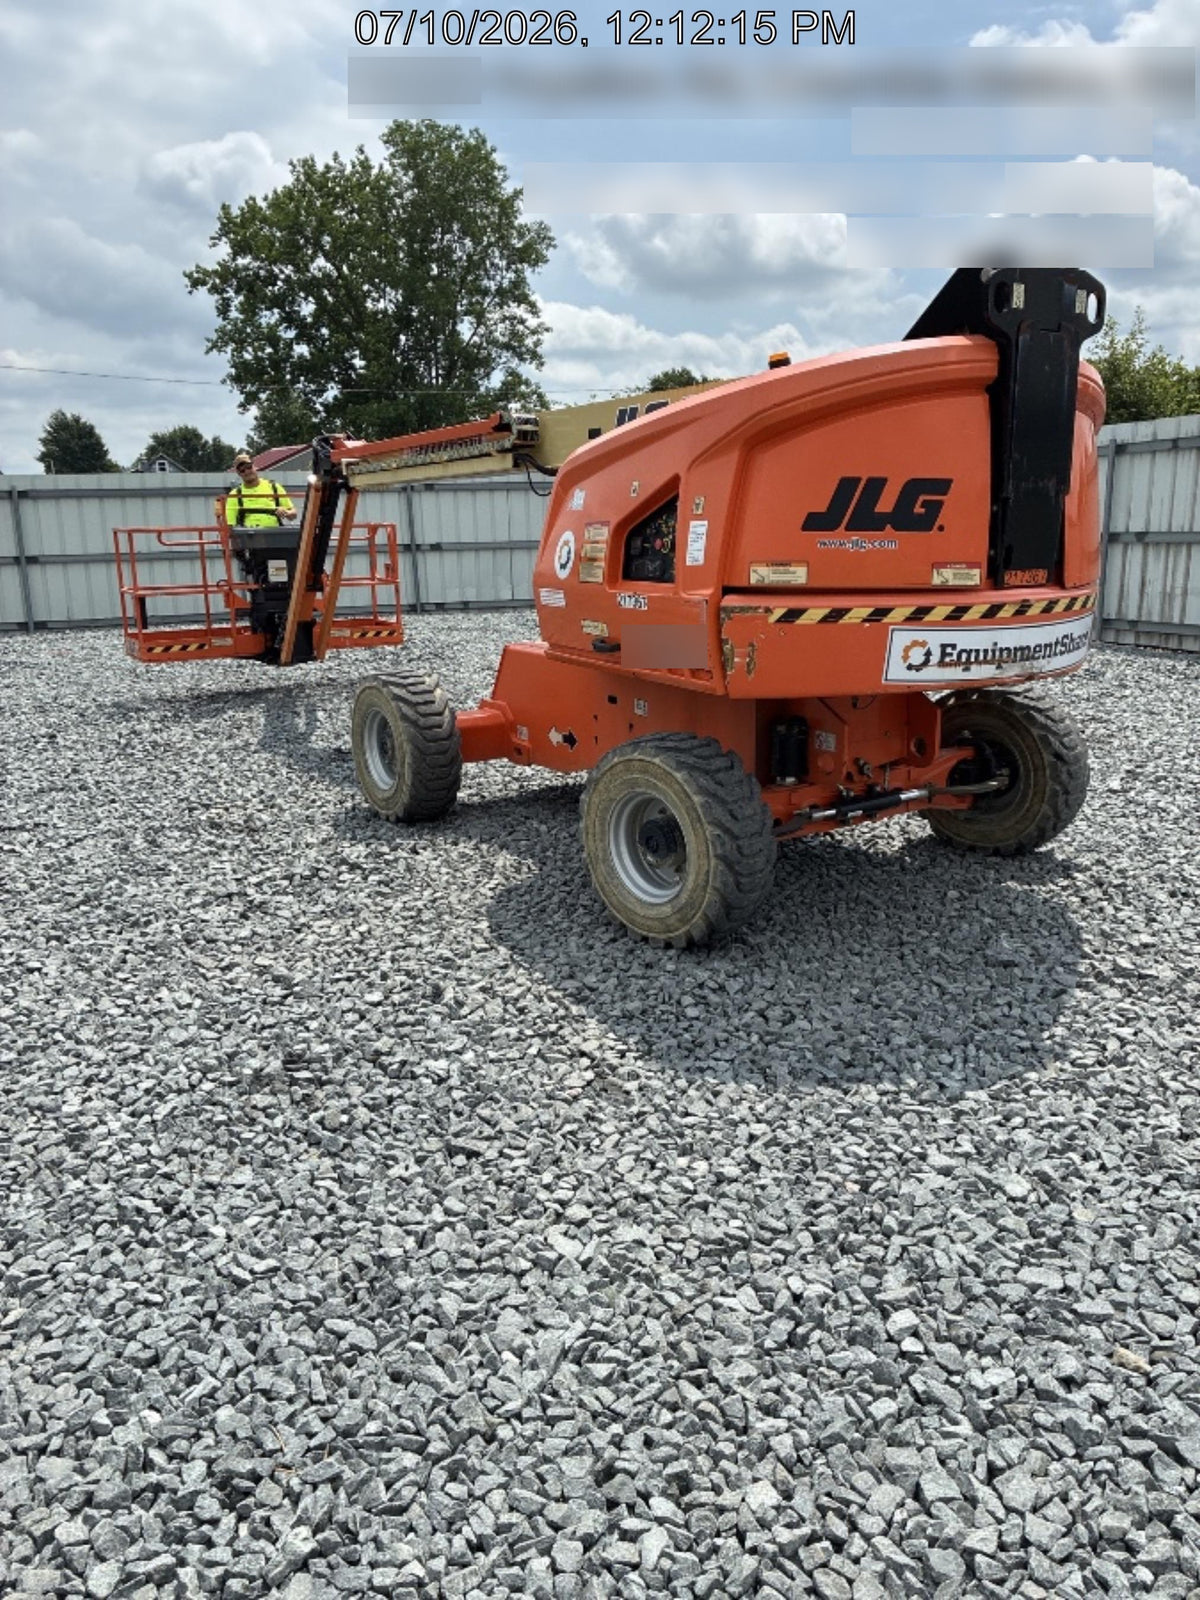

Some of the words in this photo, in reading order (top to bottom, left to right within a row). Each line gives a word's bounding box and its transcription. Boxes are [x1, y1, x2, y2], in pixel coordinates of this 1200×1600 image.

[801, 476, 953, 532] JLG
[816, 537, 898, 551] www.jlg.com
[937, 630, 1089, 672] EquipmentShar
